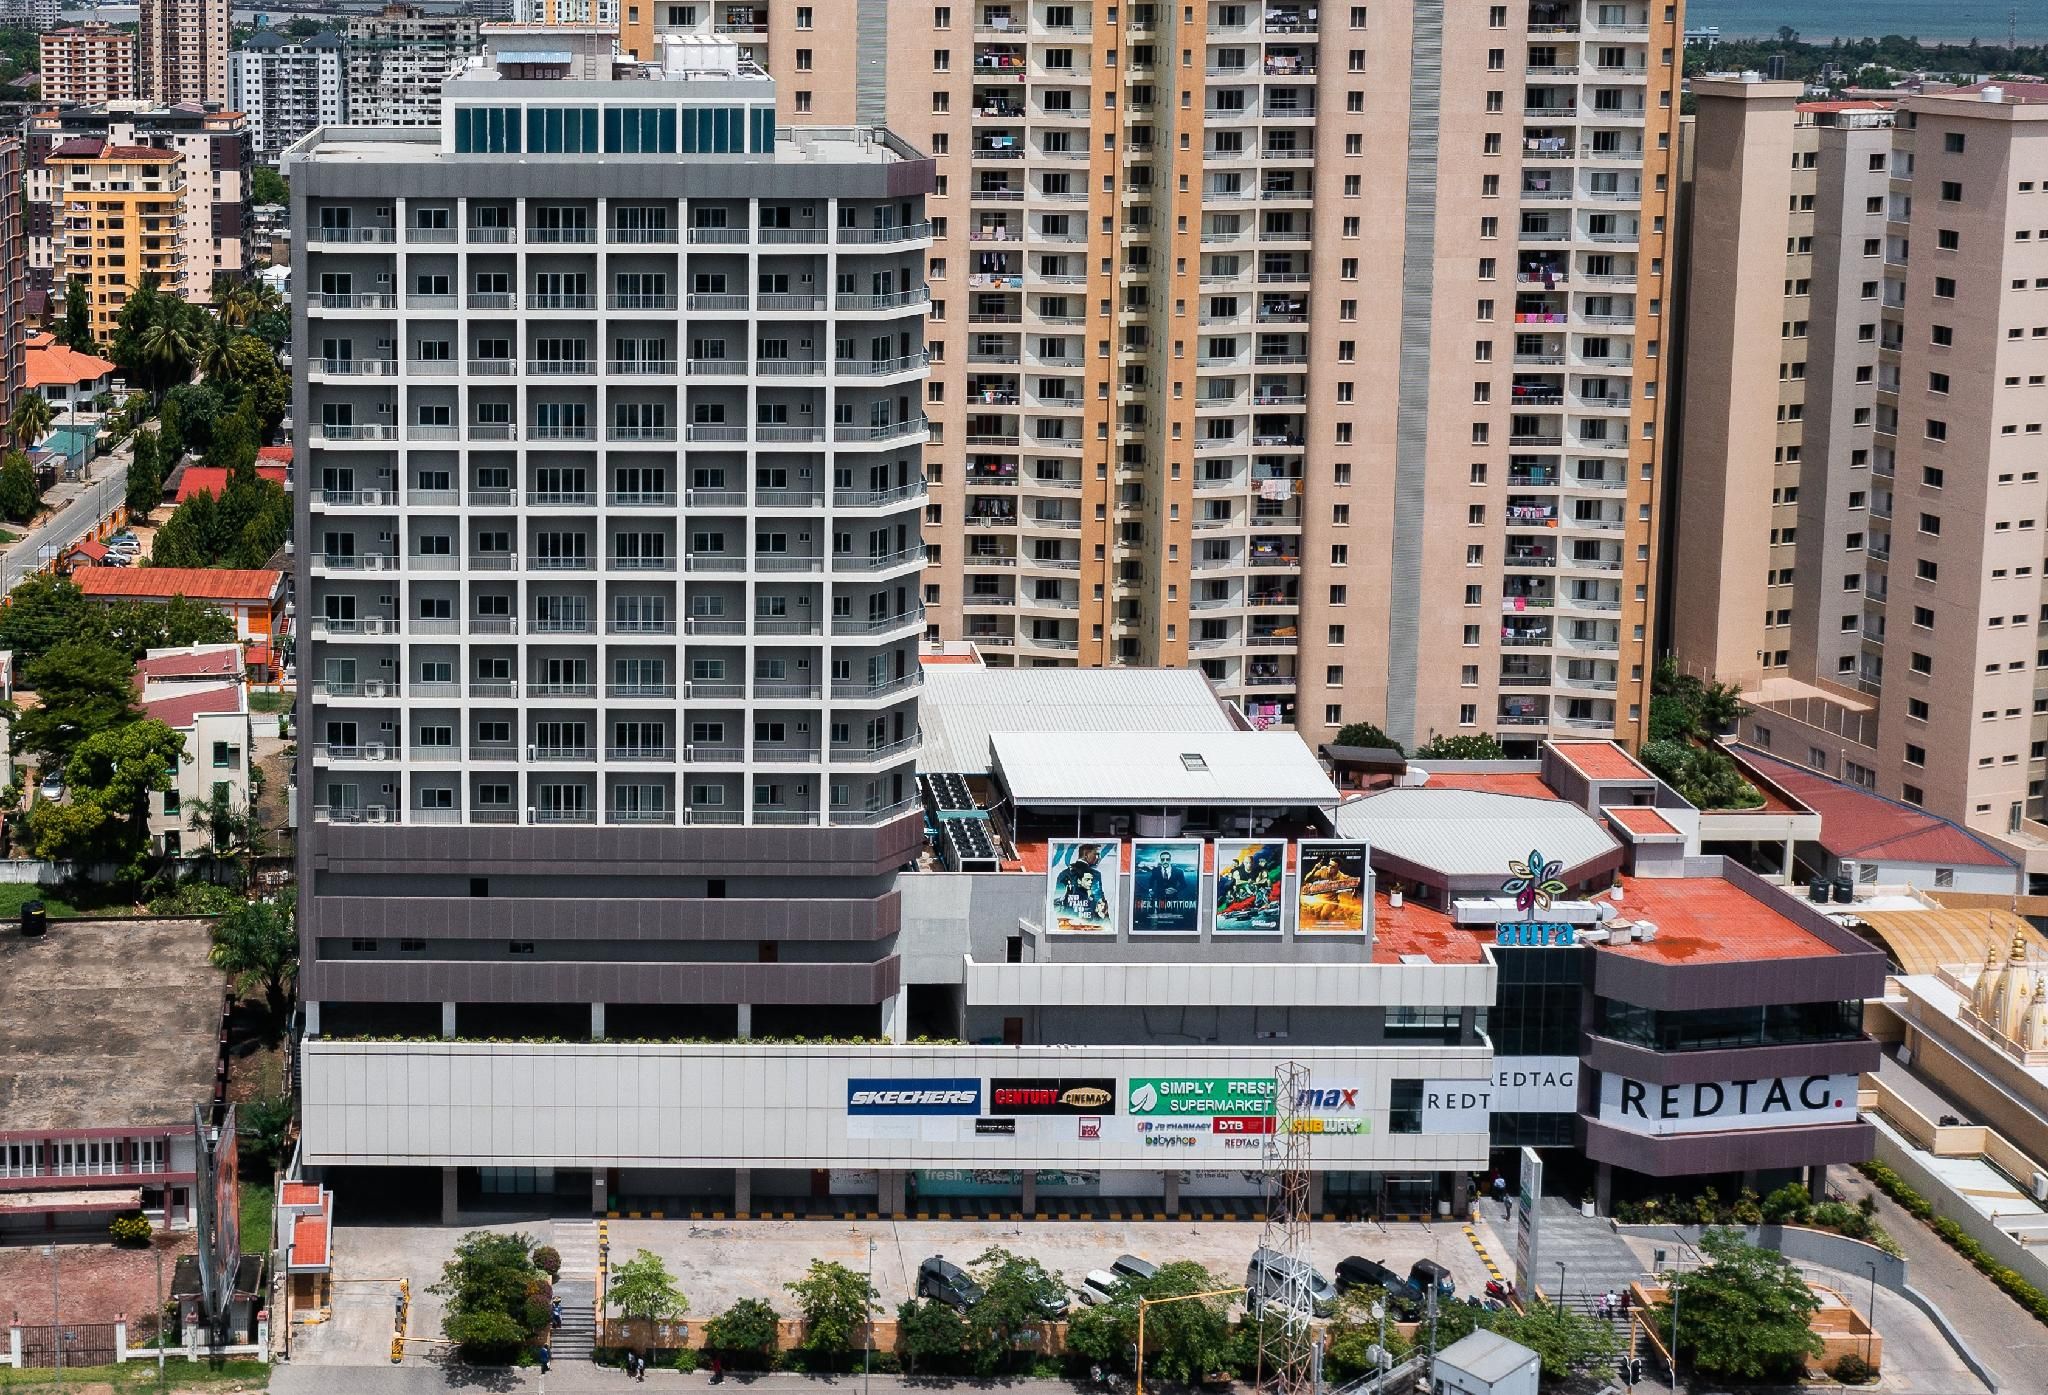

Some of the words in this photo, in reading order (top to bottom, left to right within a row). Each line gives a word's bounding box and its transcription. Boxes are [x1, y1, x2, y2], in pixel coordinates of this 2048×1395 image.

[1497, 922, 1574, 946] aura
[1489, 1072, 1573, 1087] EDTAG
[1160, 1082, 1214, 1095] SIMPLY
[1228, 1082, 1276, 1095] FRESH
[850, 1090, 978, 1105] SKECHERS
[995, 1088, 1059, 1105] CENTURY
[1066, 1093, 1109, 1105] CINEMAX
[1296, 1088, 1359, 1110] max
[1170, 1099, 1272, 1112] SUPERMARKET
[1219, 1120, 1244, 1130] DTB
[1292, 1119, 1361, 1134] SUBWAY
[1145, 1135, 1197, 1148] babyshop
[1225, 1138, 1260, 1148] REDTAG
[924, 1169, 962, 1181] fresh
